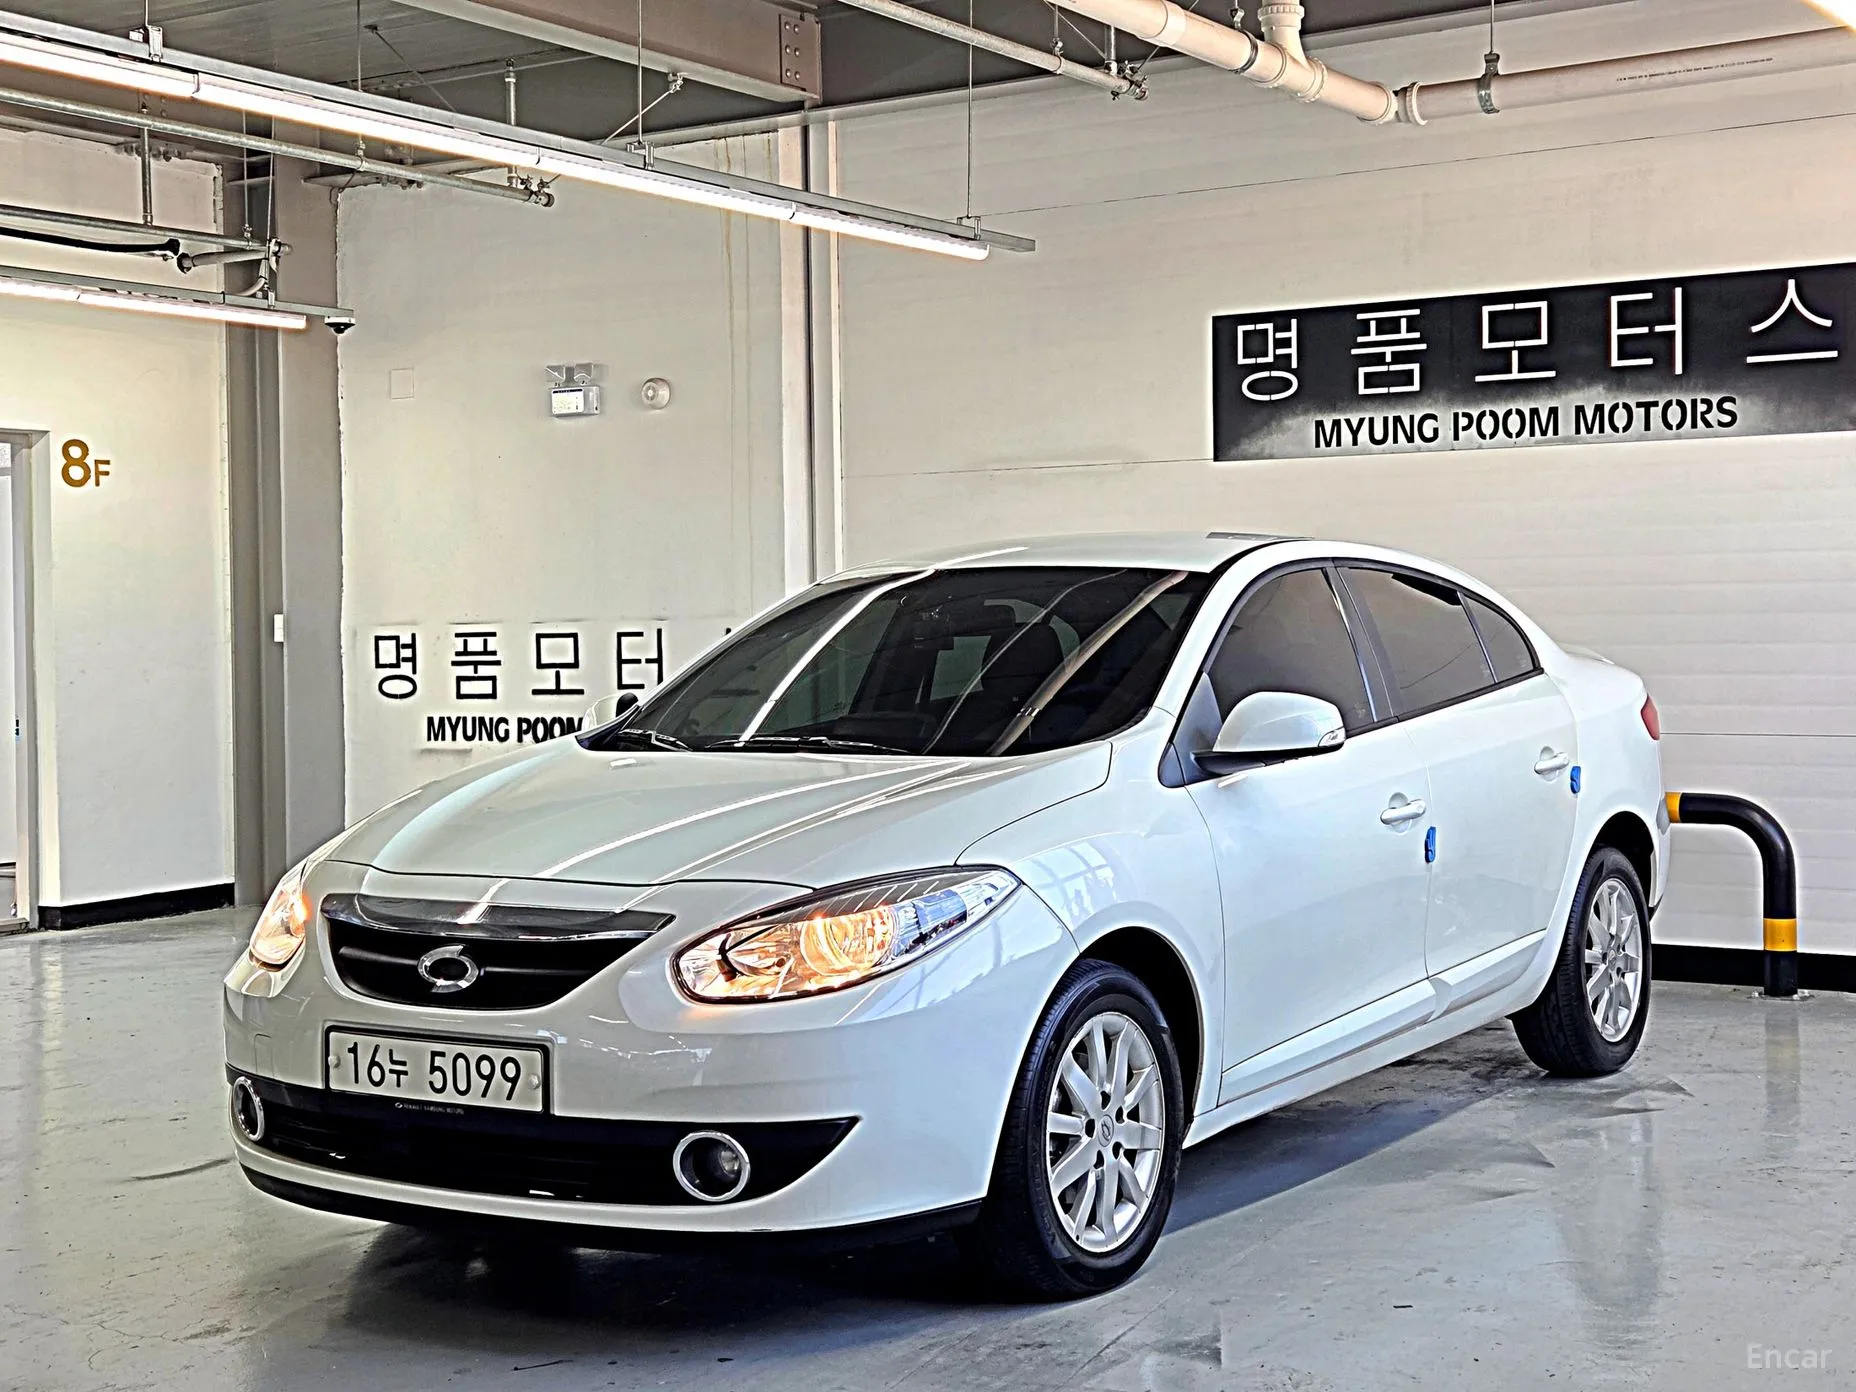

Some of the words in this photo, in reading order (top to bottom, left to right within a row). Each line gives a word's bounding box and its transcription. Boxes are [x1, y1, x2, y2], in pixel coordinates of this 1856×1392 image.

[1237, 279, 1838, 401] 명품모터스
[1314, 413, 1439, 449] MYUNG
[1453, 406, 1559, 442] POOM
[1574, 395, 1738, 435] MOTORS
[61, 438, 111, 488] 8F
[374, 628, 732, 700] 명품모터
[427, 716, 510, 743] MYUNG
[347, 1041, 409, 1088] 16누
[428, 1050, 522, 1101] 5099
